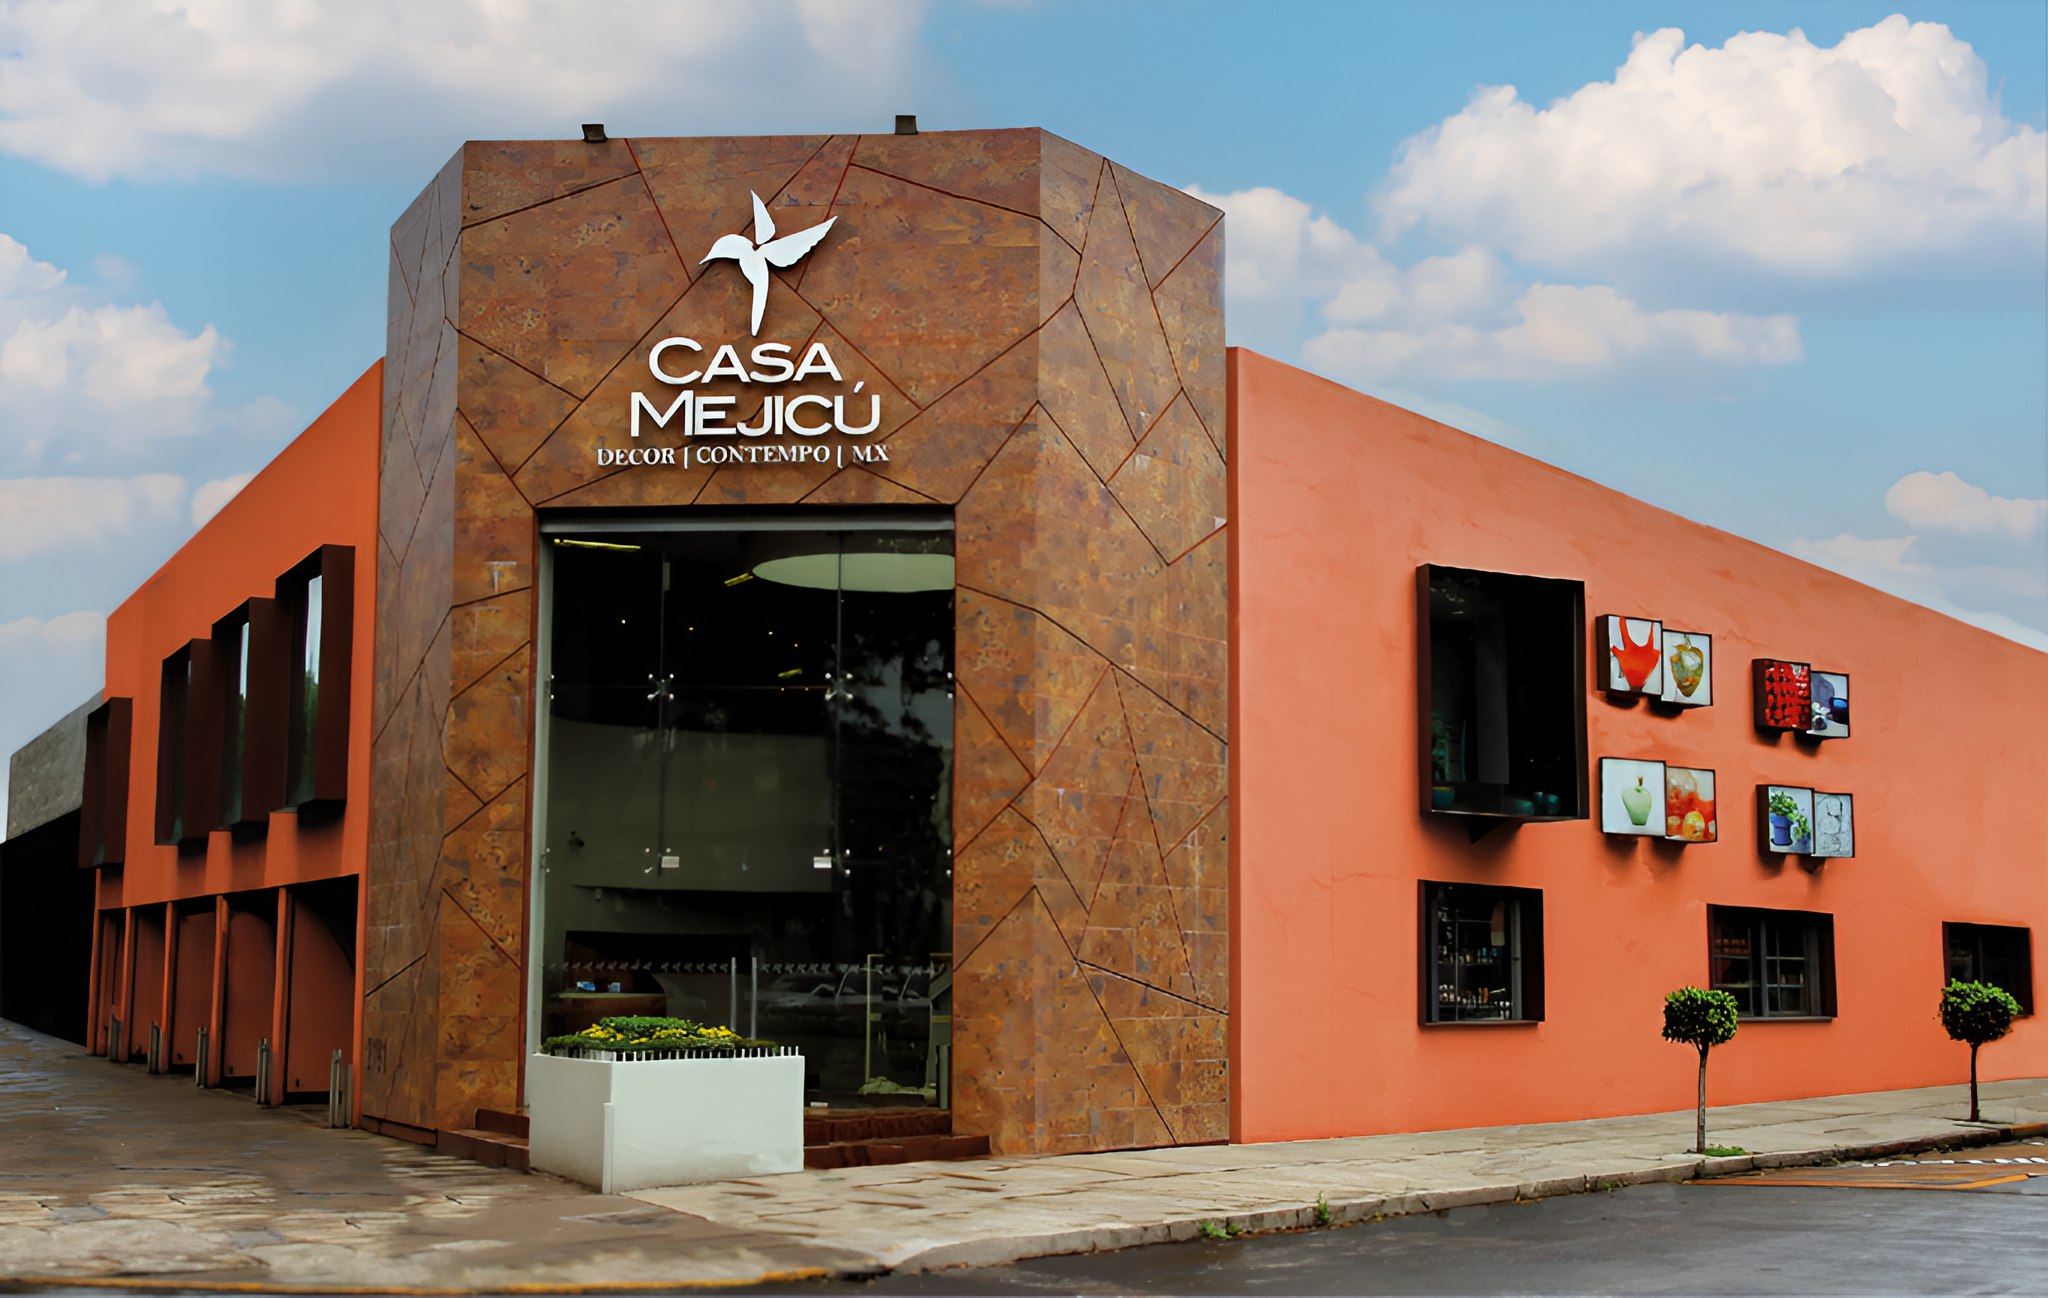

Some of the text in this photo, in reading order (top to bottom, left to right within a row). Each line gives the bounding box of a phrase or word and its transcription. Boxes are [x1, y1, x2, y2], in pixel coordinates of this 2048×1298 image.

[649, 336, 843, 384] CASA
[631, 381, 881, 437] MEJICÚ
[597, 447, 675, 466] DECOR
[696, 445, 830, 465] CONTEMPO
[852, 444, 890, 462] MX
